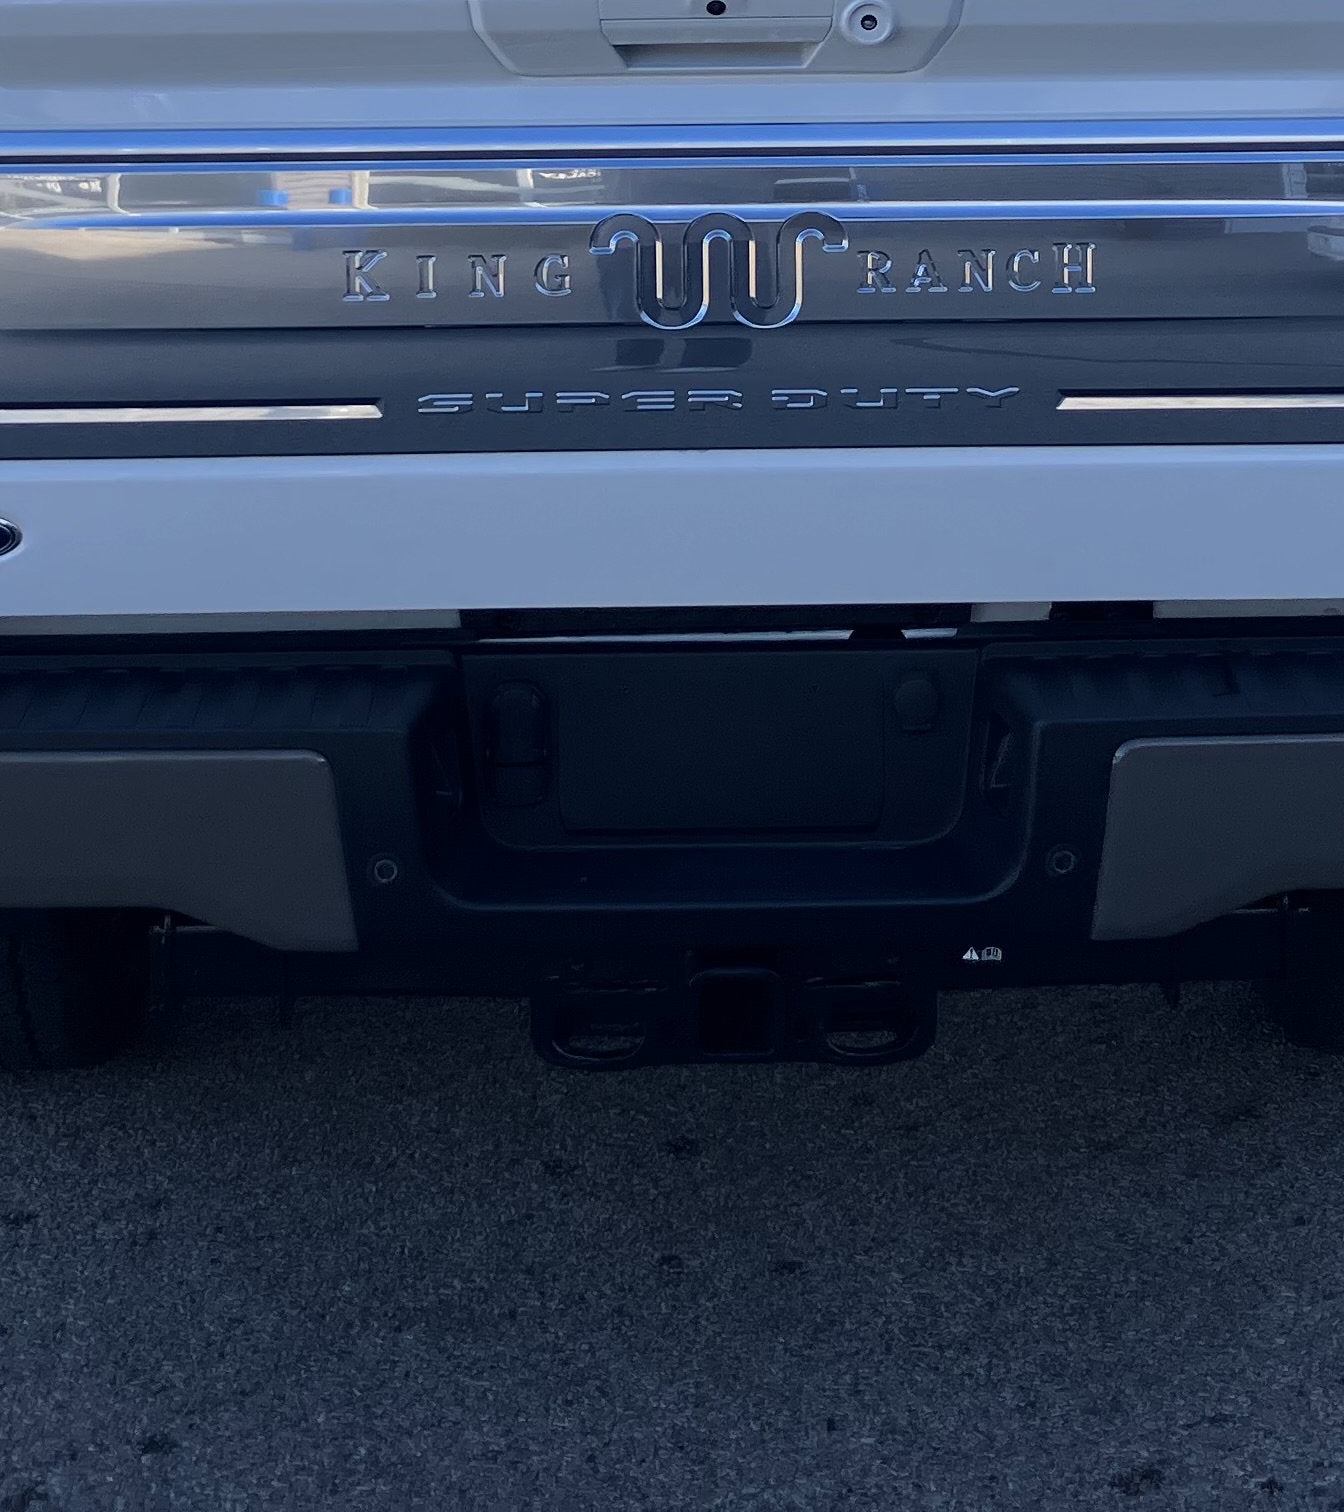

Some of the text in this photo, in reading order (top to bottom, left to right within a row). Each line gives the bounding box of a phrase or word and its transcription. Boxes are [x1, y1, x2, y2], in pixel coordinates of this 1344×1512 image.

[342, 242, 1096, 302] KING RANCH
[417, 387, 1020, 414] SUPER DUTY
